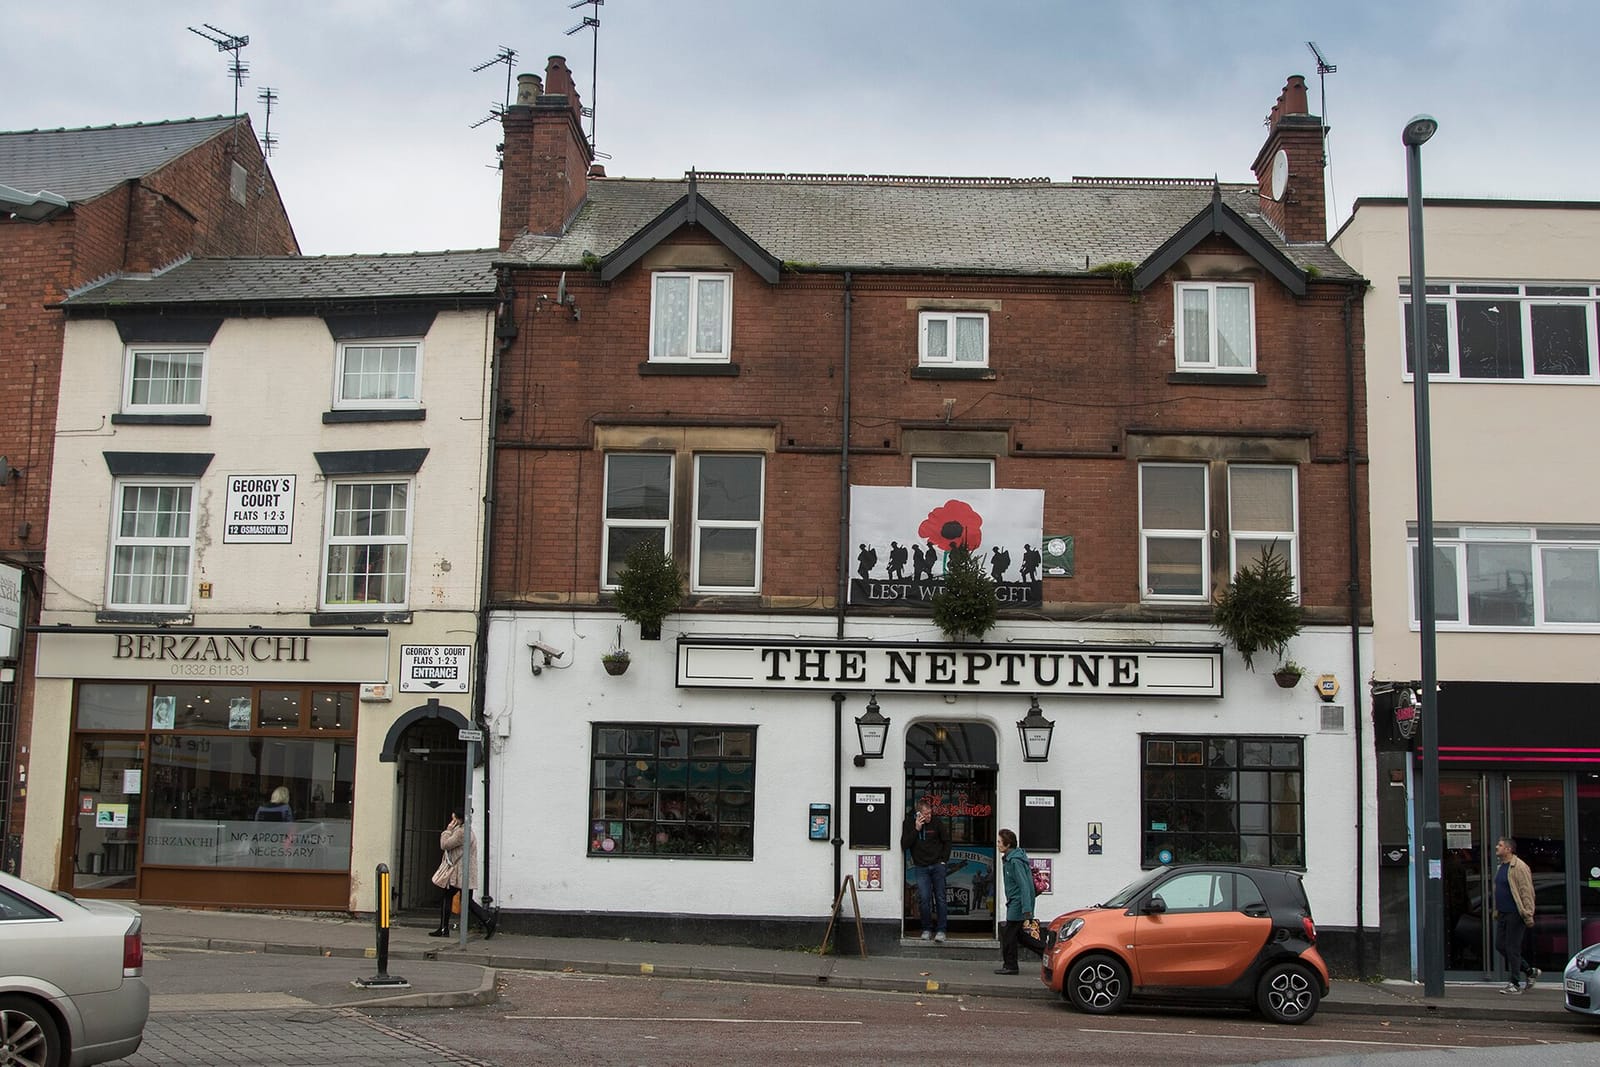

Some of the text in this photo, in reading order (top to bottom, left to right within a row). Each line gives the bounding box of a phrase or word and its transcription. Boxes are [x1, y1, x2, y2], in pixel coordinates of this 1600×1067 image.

[233, 478, 290, 493] GEORGY'S
[241, 494, 280, 507] COURT
[233, 510, 259, 521] FLATS
[230, 526, 287, 535] 12 OSMASTON RD
[868, 583, 911, 600] LEST
[112, 634, 311, 662] BERZANCHI
[405, 647, 466, 656] GEORGY'S COURT
[413, 656, 433, 665] FLATS
[171, 664, 250, 676] 01332 611831
[413, 667, 457, 678] ENTRANCE
[760, 648, 1140, 688] THE NEPTUNE
[147, 835, 213, 848] BERZANCHI
[230, 832, 335, 845] NO APPOINTMENT
[248, 847, 315, 857] NECESSARY
[952, 850, 983, 861] DERBY
